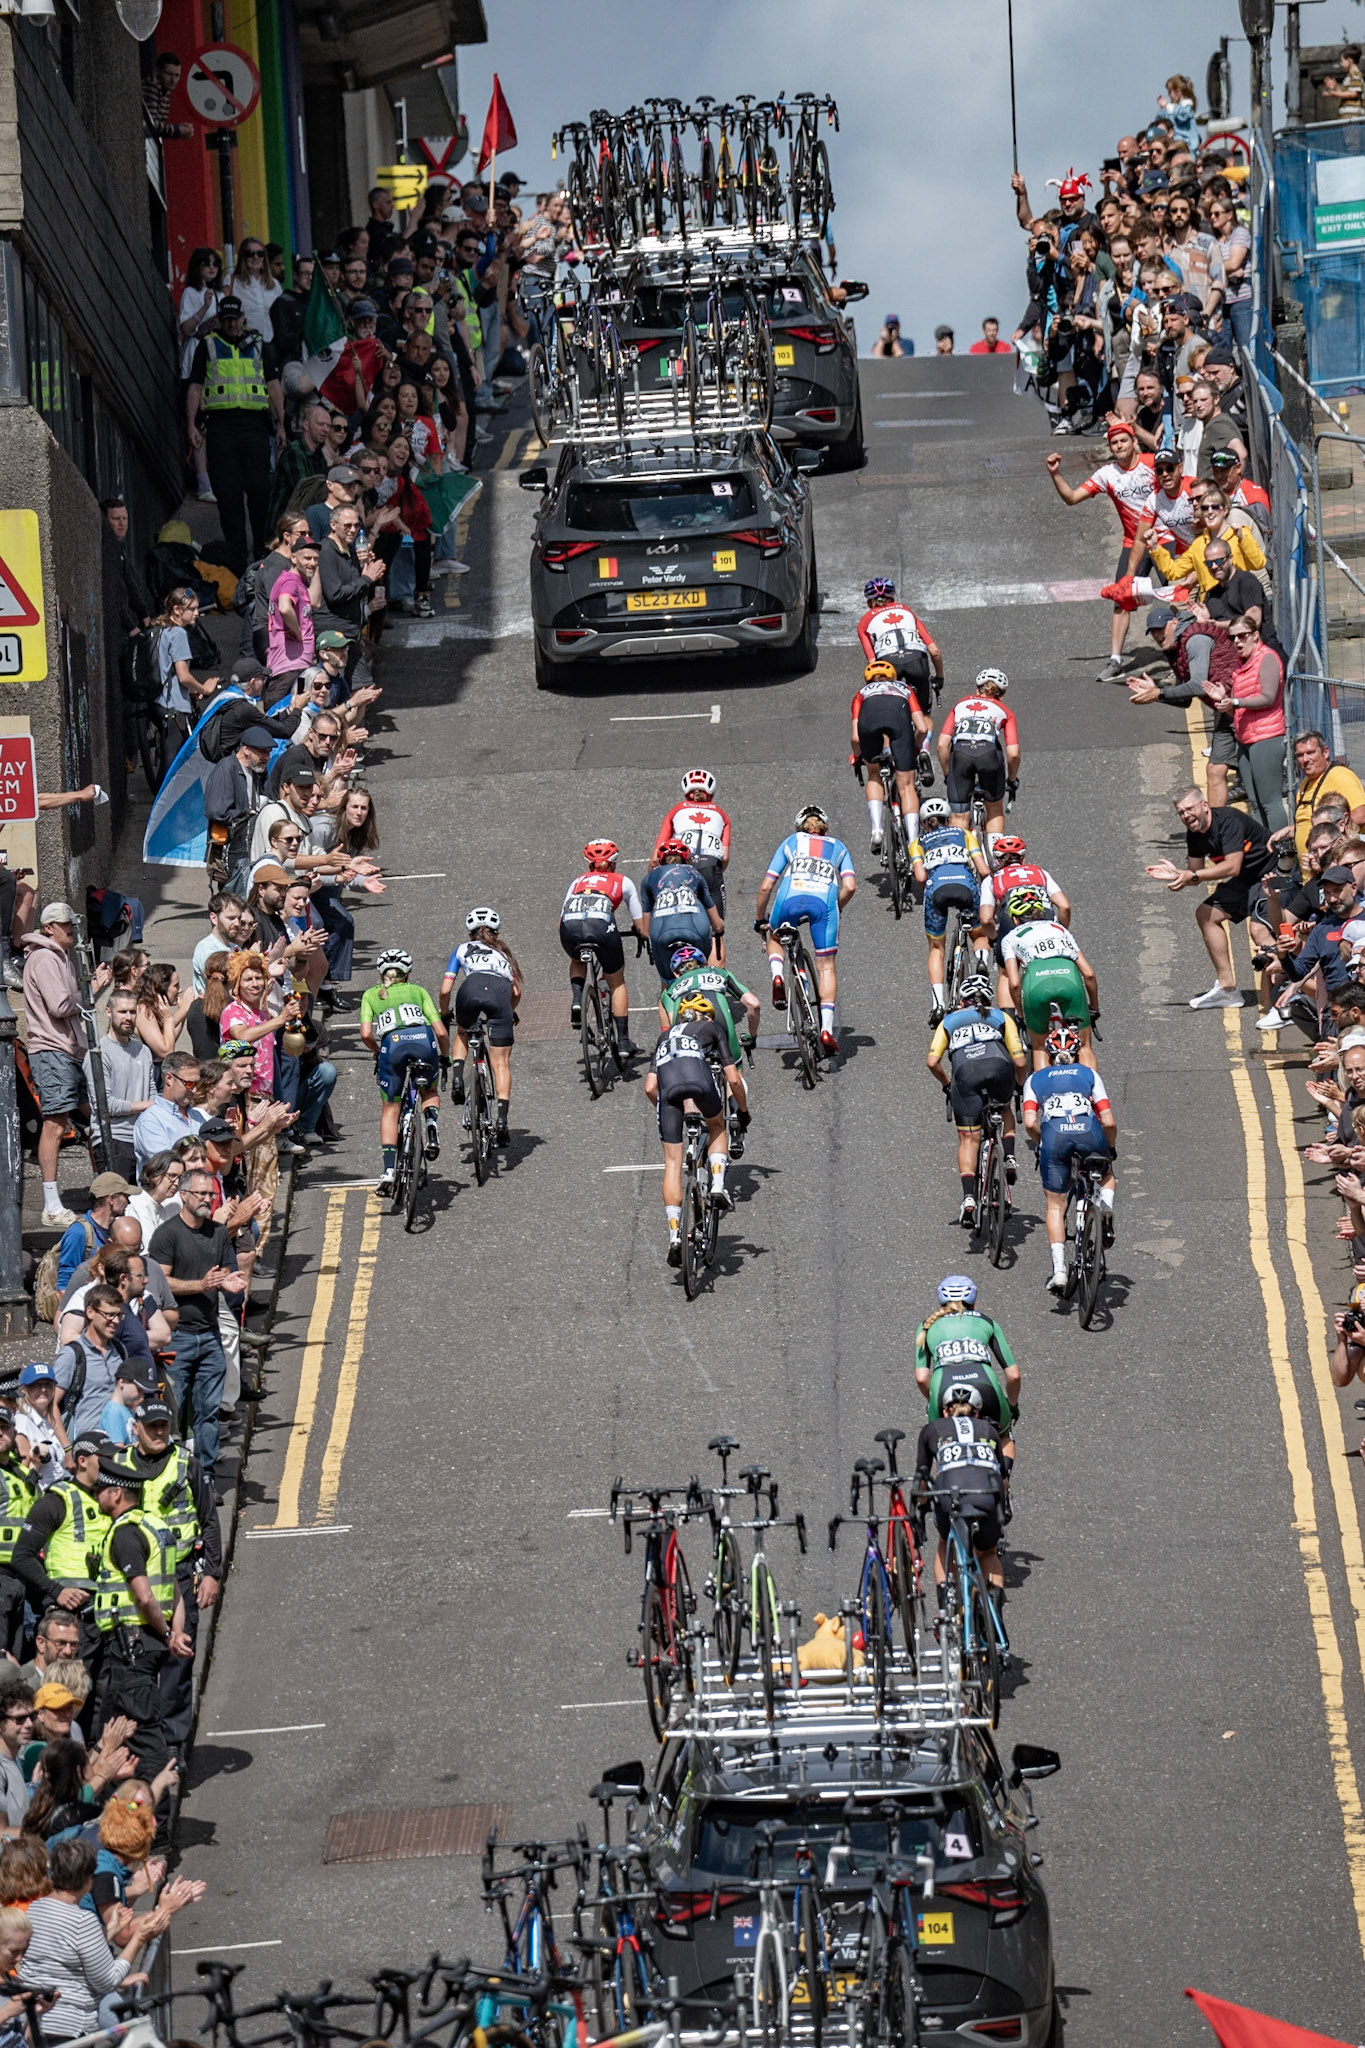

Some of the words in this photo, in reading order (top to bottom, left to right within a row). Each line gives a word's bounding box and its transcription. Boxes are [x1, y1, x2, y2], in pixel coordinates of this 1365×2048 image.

[1317, 211, 1365, 224] EMERGENC
[1321, 225, 1342, 234] EXIT
[778, 351, 790, 359] 103
[718, 485, 726, 493] 3
[642, 575, 662, 584] Peter
[663, 573, 686, 583] Vardy
[634, 592, 669, 607] SL23
[673, 591, 700, 605] ZKD
[955, 720, 970, 733] 79
[976, 721, 991, 733] 79
[708, 835, 720, 850] 78
[925, 848, 942, 864] 124
[947, 846, 965, 858] 124
[792, 859, 813, 873] 127
[815, 862, 834, 878] 127
[656, 894, 674, 909] 129
[676, 890, 696, 906] 129
[569, 898, 582, 912] 41
[593, 899, 608, 912] 41
[1034, 940, 1055, 954] 188
[702, 975, 722, 985] 169
[403, 1006, 423, 1018] 118
[681, 1037, 699, 1050] 86
[1048, 1069, 1079, 1078] FRANCE
[1047, 1097, 1063, 1110] 32
[1060, 1123, 1086, 1132] FRANCE
[938, 1341, 961, 1358] 168
[963, 1340, 987, 1357] 168
[952, 1372, 979, 1381] IRELAND
[147, 1404, 168, 1412] POLICE
[943, 1445, 962, 1463] 89
[976, 1445, 995, 1461] 89
[951, 1839, 963, 1852] 4
[928, 1923, 948, 1934] 104
